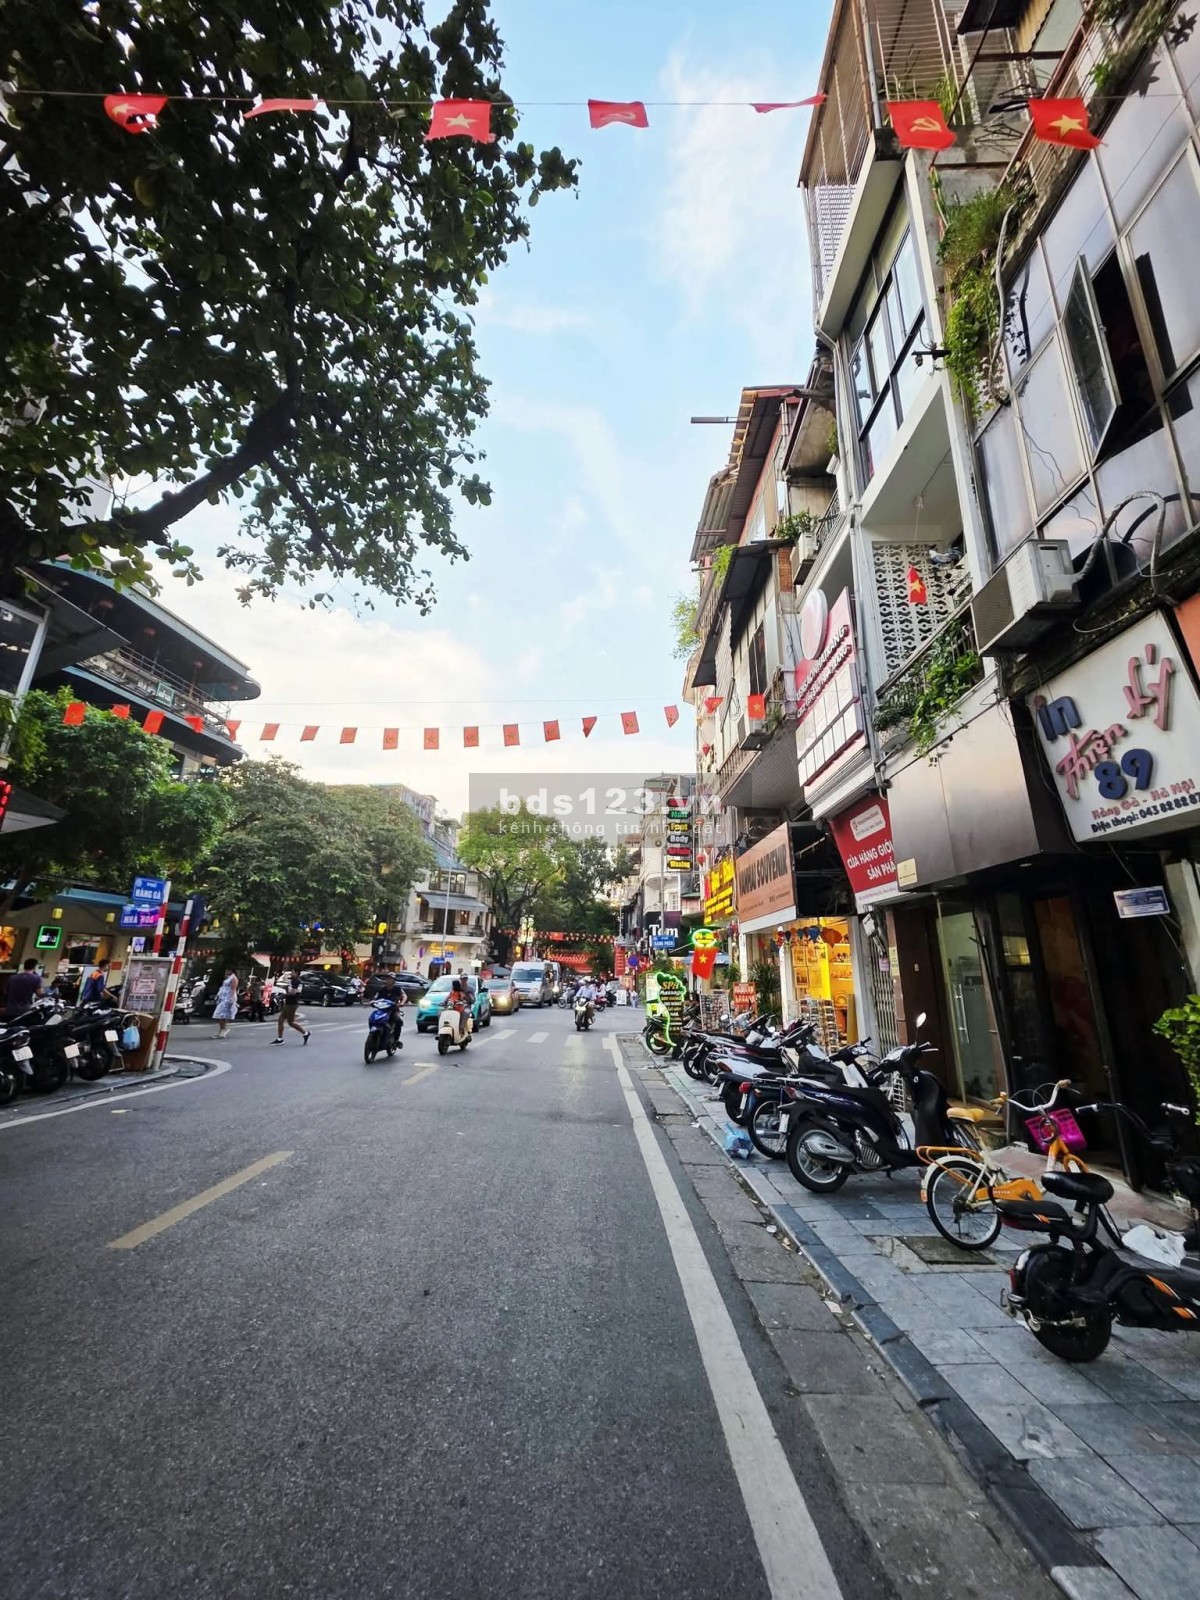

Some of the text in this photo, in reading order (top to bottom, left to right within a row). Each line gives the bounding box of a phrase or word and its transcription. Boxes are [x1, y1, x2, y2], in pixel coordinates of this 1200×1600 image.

[1034, 694, 1083, 742] in
[1094, 748, 1154, 800] 89
[860, 846, 879, 864] HÀNG
[881, 855, 896, 875] PHẨ
